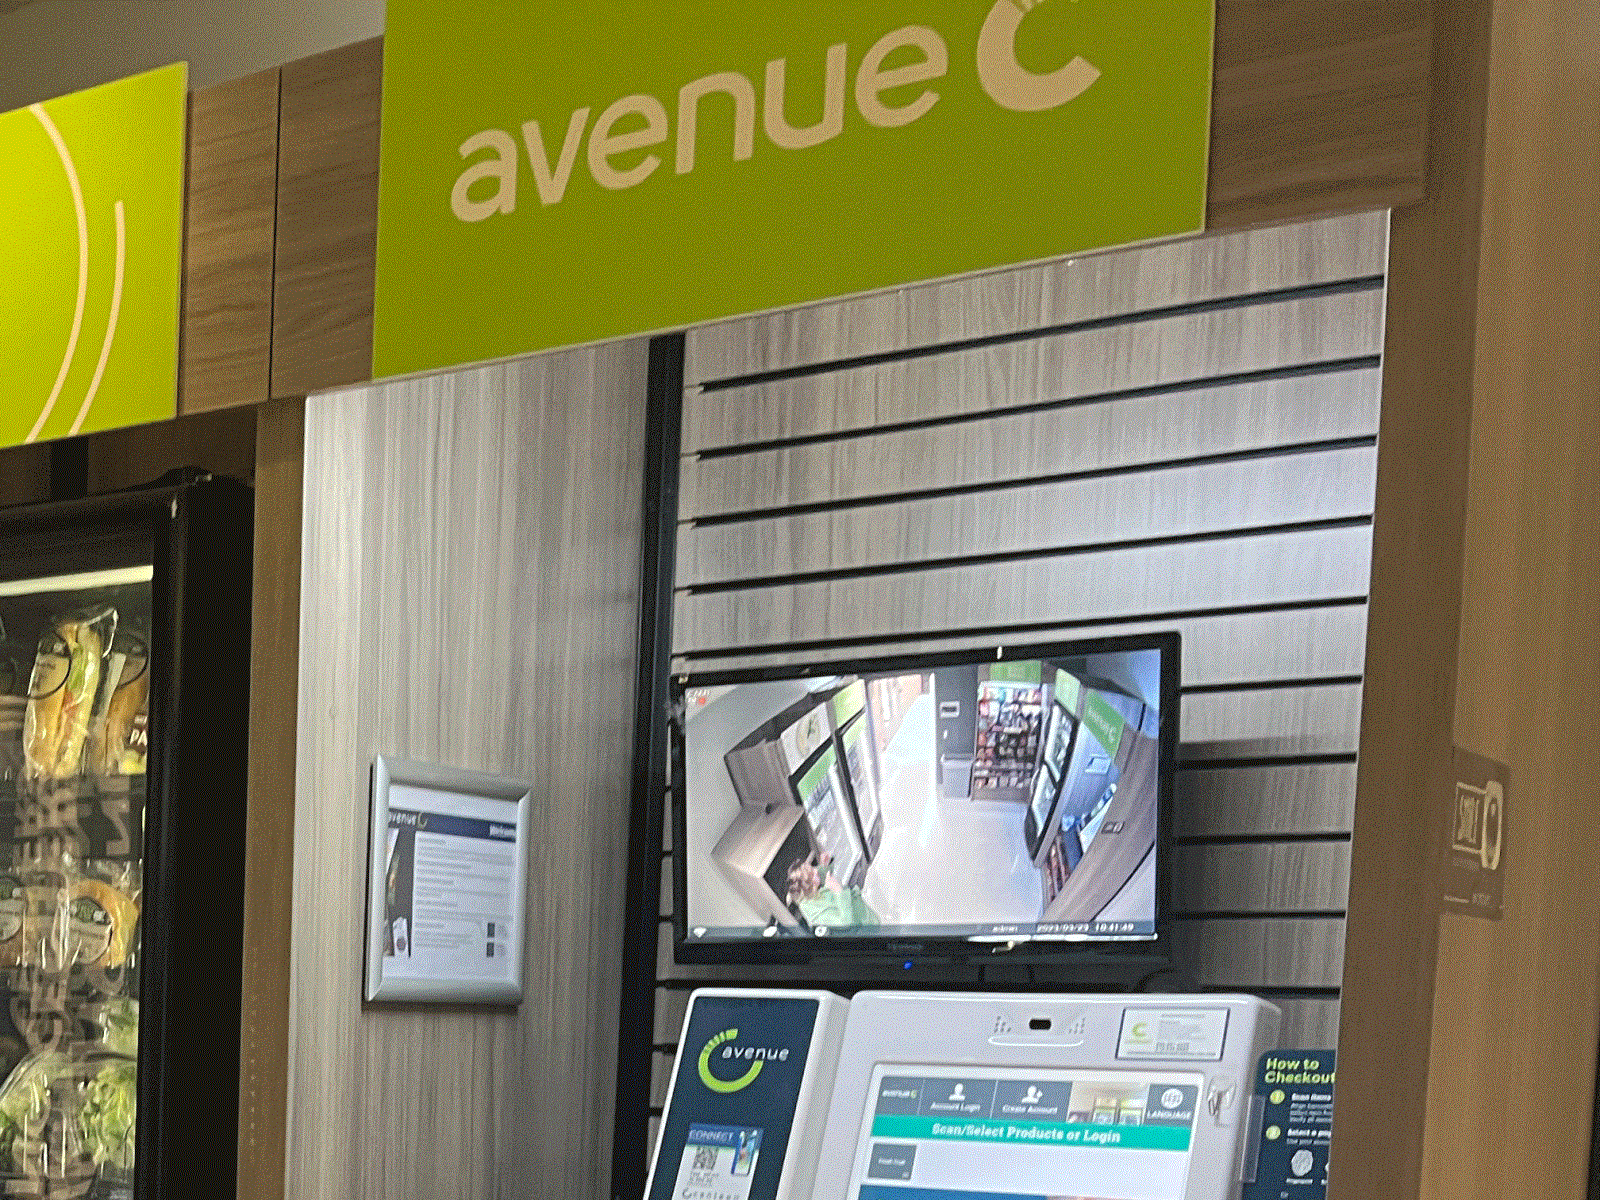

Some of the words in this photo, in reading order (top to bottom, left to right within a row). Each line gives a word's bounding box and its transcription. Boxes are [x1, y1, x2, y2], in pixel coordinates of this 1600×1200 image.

[449, 24, 949, 223] avenue
[722, 1046, 790, 1062] avenue
[1265, 1058, 1300, 1070] How
[1303, 1058, 1320, 1070] to
[1264, 1071, 1336, 1085] Checkout
[930, 1101, 959, 1112] Account
[961, 1103, 981, 1114] Login
[1002, 1105, 1026, 1114] Create
[1027, 1105, 1058, 1115] Account
[1147, 1109, 1193, 1121] LANGUAGE
[931, 1122, 1004, 1139] Scan/Select
[1007, 1126, 1065, 1142] Products
[1067, 1130, 1081, 1142] or
[1083, 1130, 1121, 1146] Login
